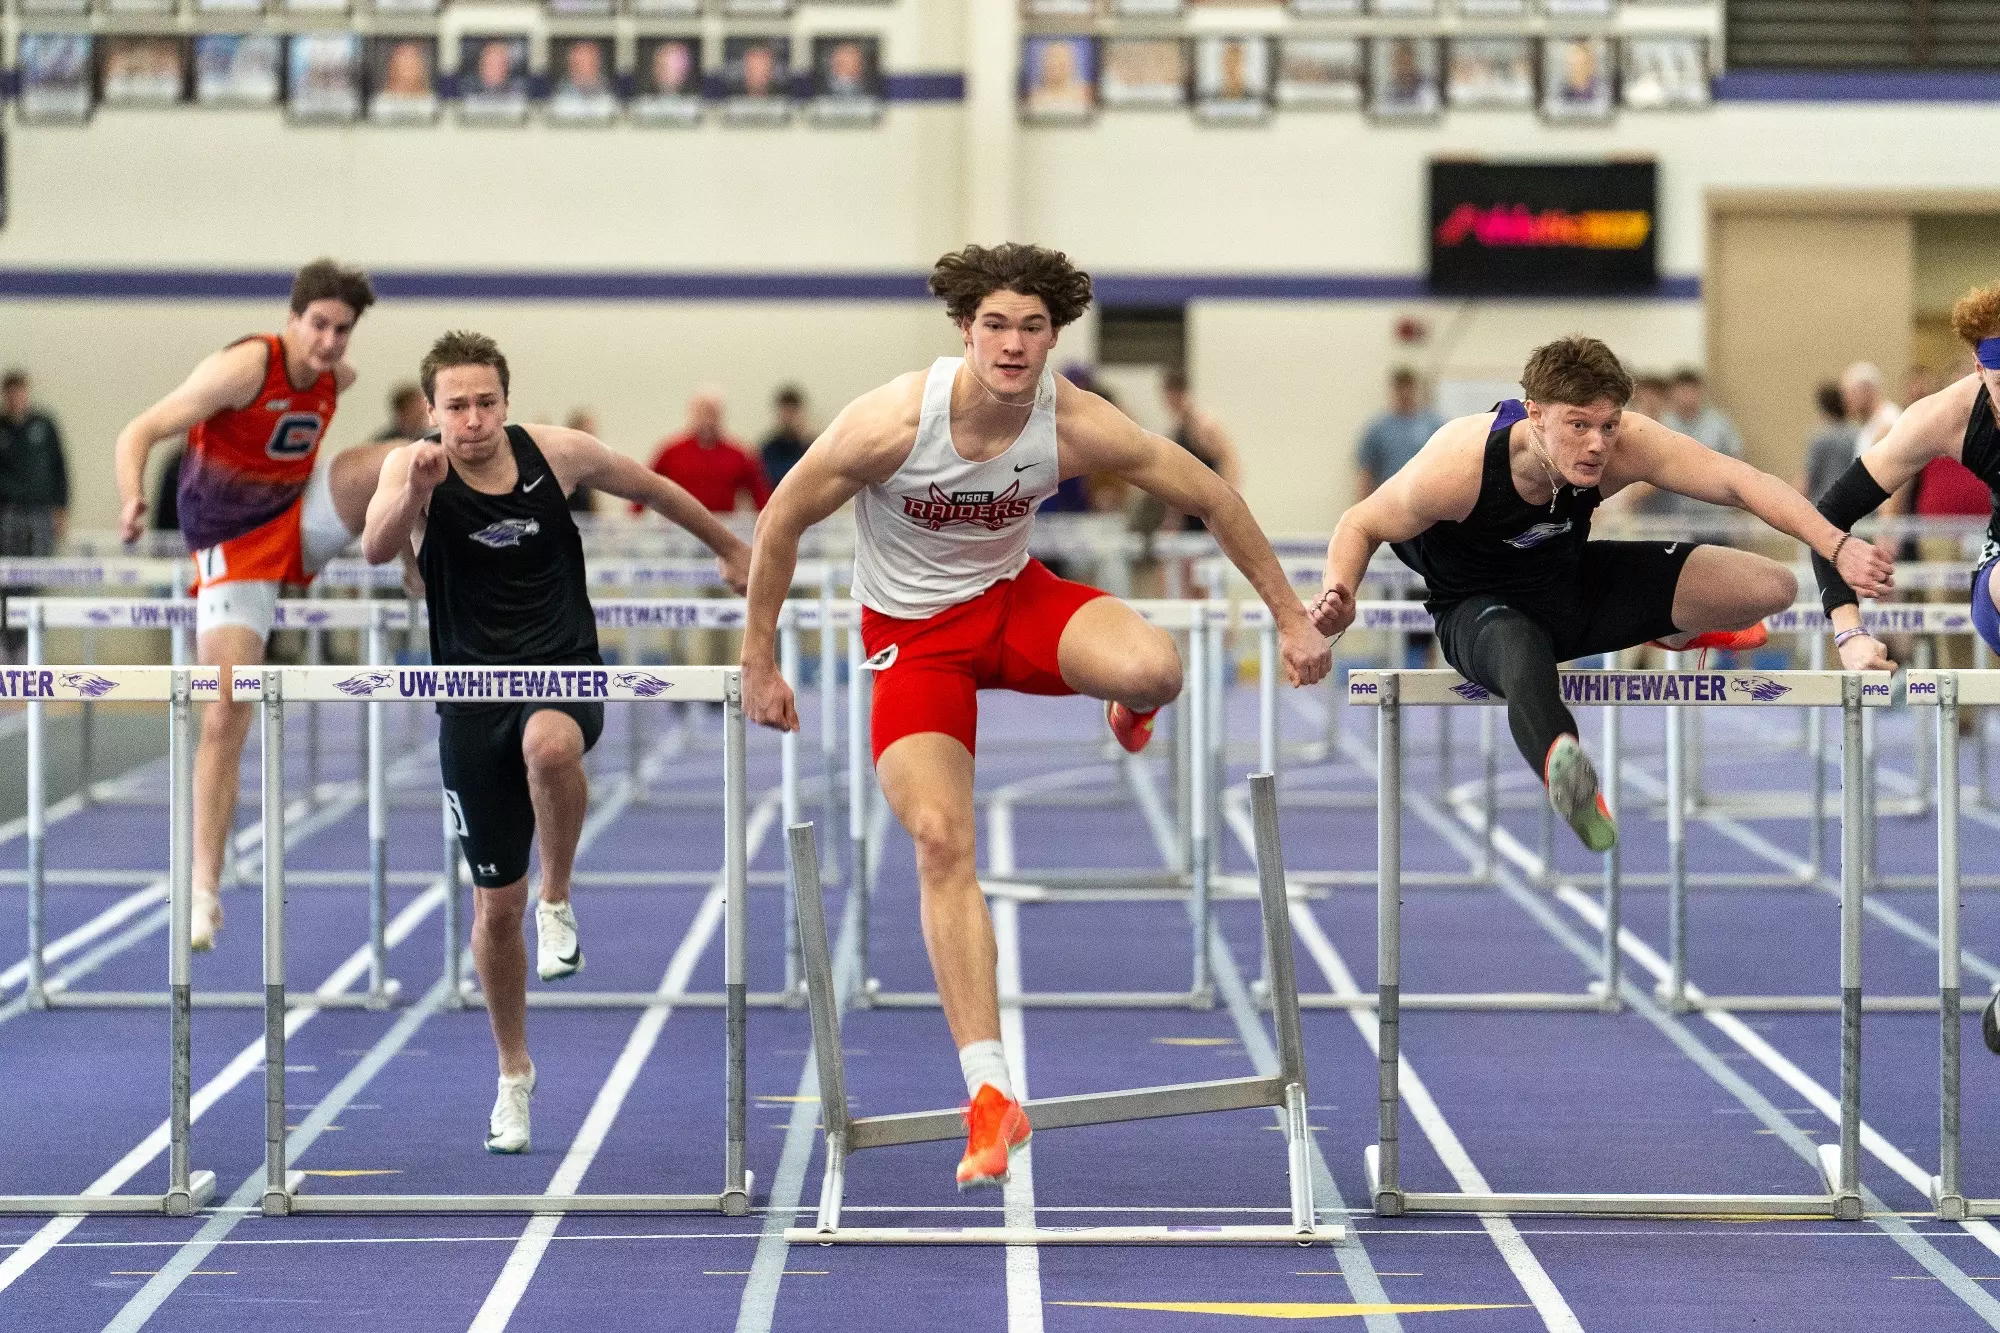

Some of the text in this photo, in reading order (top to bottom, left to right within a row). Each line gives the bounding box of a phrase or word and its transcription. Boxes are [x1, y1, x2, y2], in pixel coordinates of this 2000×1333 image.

[266, 412, 322, 460] C
[908, 499, 1029, 519] RAIDERS
[400, 670, 609, 697] UW-WHITEWATER
[1561, 674, 1727, 701] WHITEWATER
